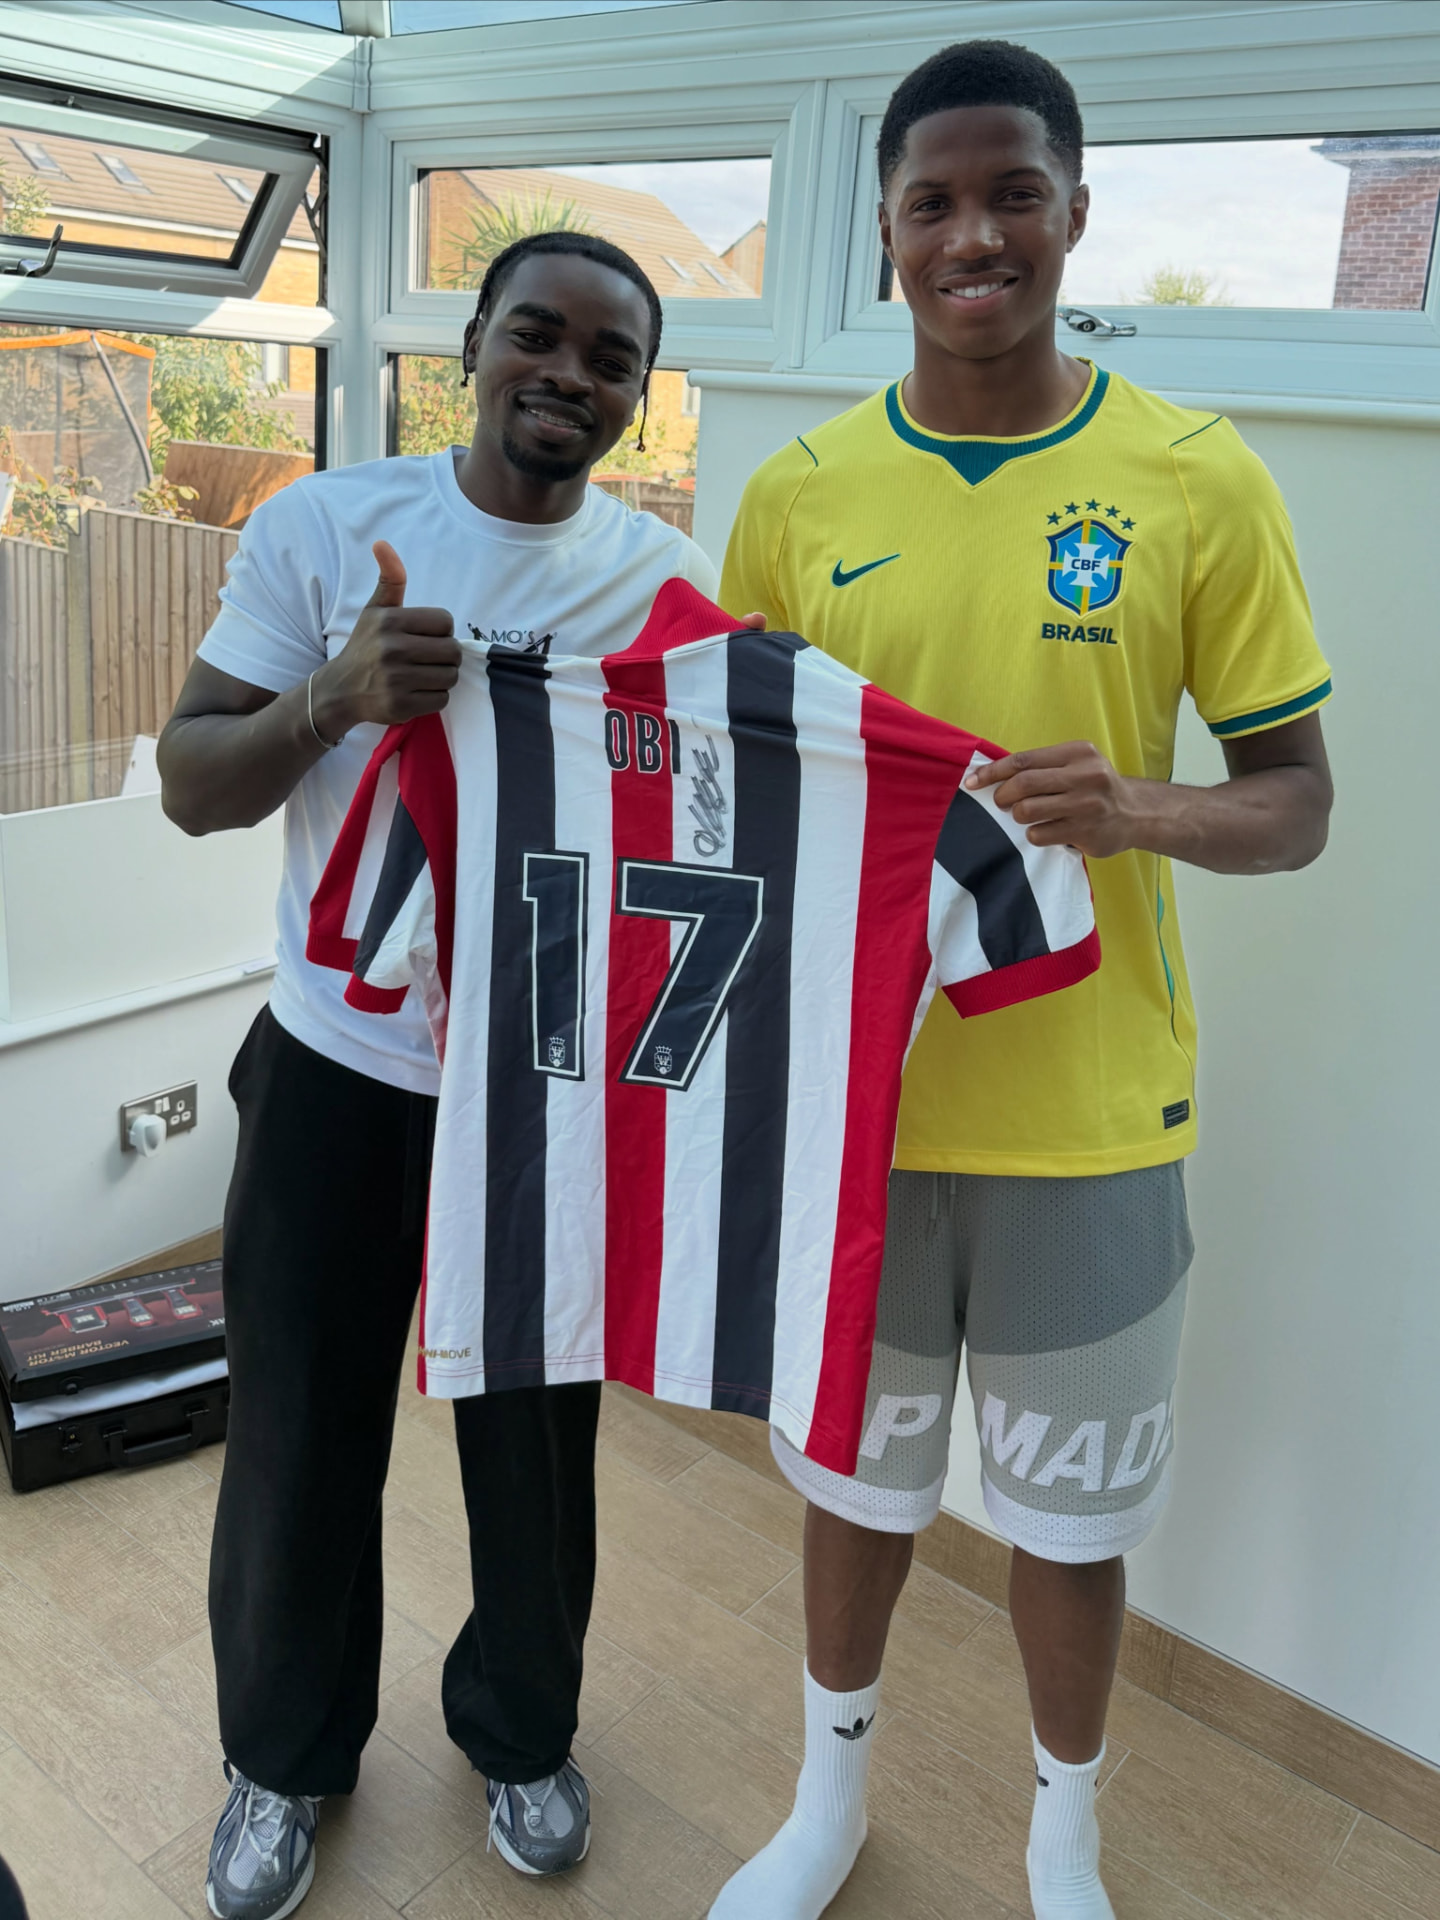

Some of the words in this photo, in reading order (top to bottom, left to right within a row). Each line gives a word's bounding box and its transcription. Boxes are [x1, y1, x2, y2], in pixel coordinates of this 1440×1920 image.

[1071, 558, 1102, 571] CBF
[490, 628, 536, 645] MO'S
[1041, 622, 1118, 645] BRASIL
[604, 708, 682, 775] OBI
[521, 851, 766, 1092] 17
[50, 1339, 102, 1357] BARBER
[79, 1339, 130, 1355] VECTOR
[27, 1352, 47, 1362] KIT
[858, 1393, 942, 1461] P
[981, 1390, 1173, 1492] MAD
